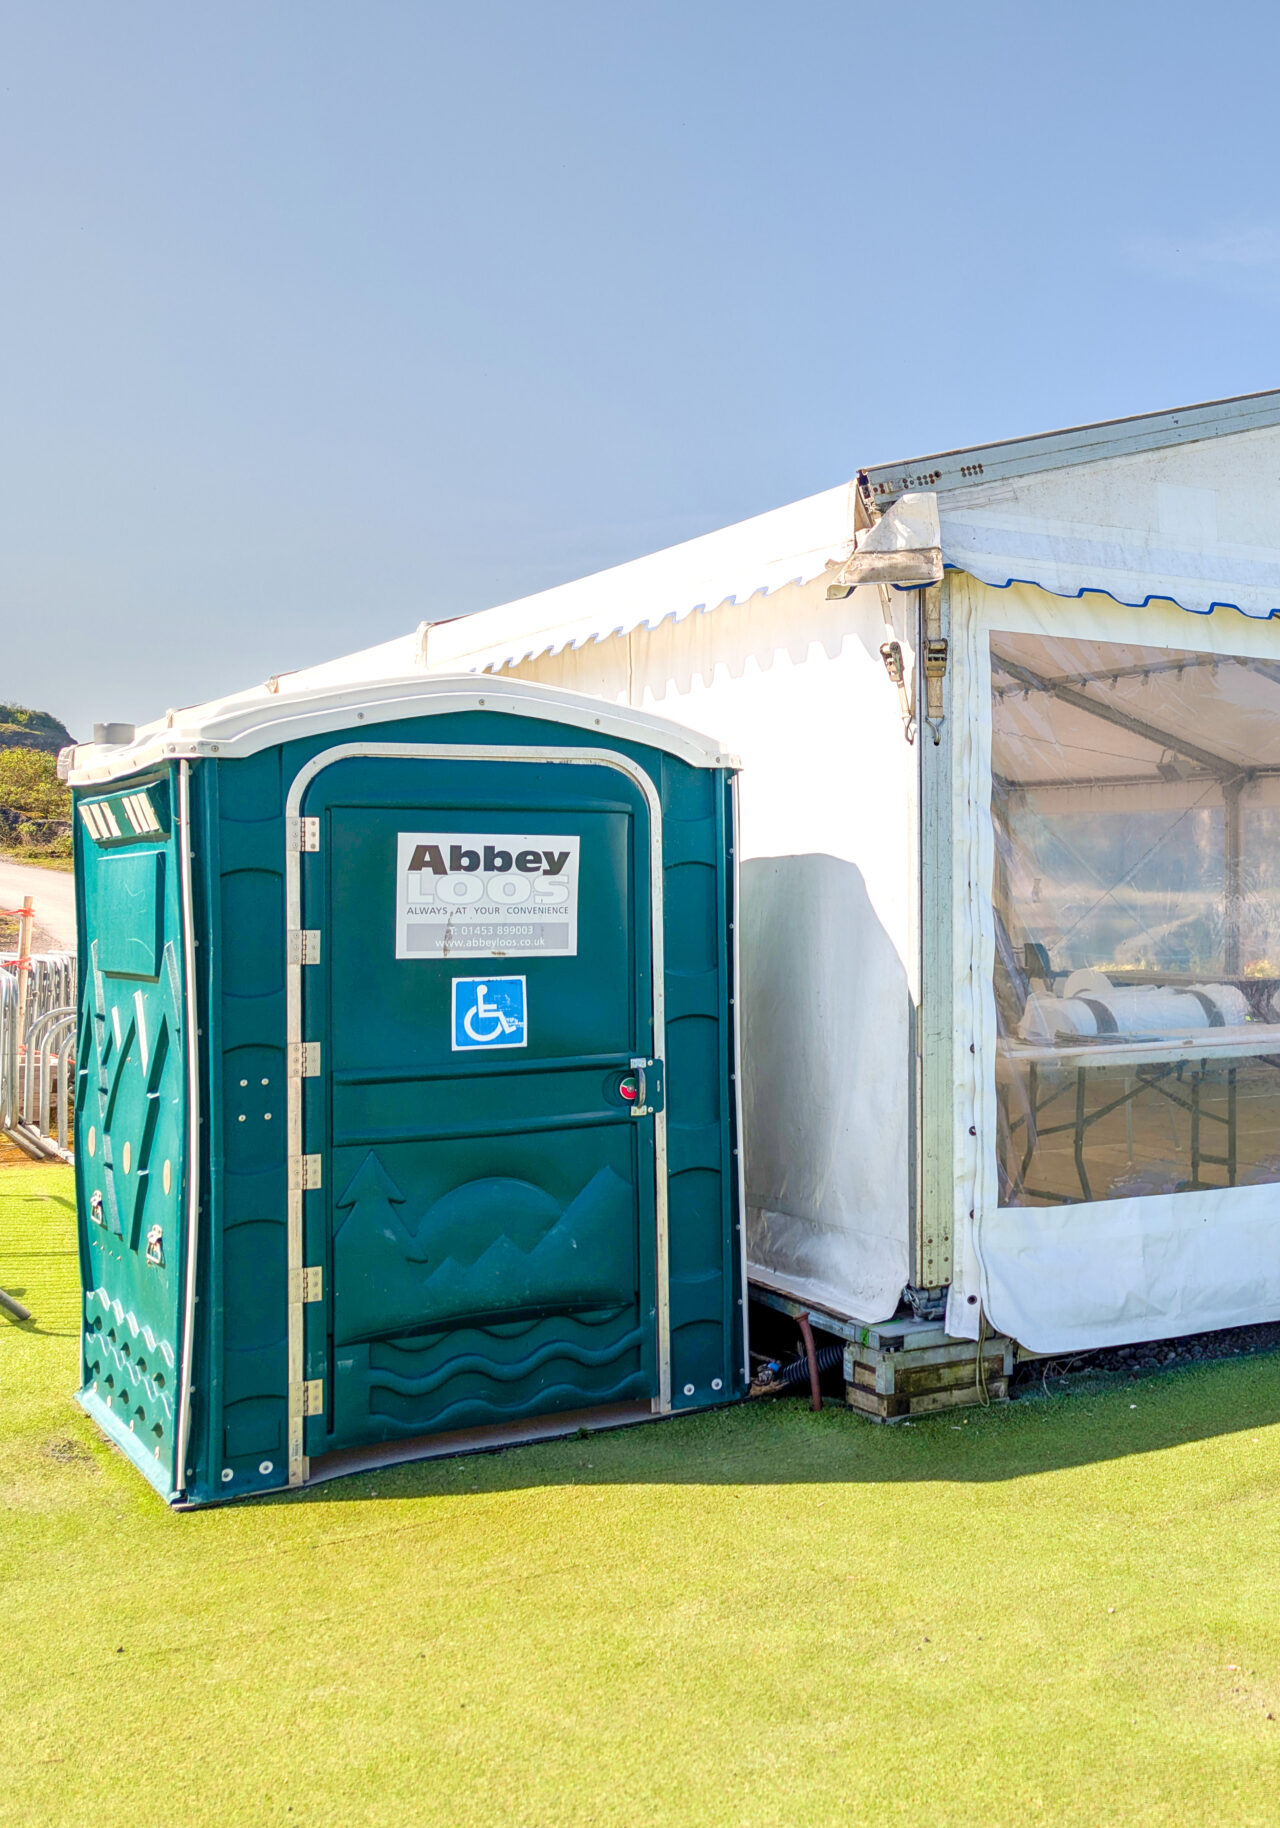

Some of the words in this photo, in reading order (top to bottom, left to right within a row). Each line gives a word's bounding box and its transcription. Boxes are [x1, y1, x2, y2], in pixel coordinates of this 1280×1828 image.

[407, 844, 570, 876] Abbey
[406, 872, 570, 905] LOOS
[406, 906, 448, 915] ALWAYS
[455, 906, 467, 915] AT
[473, 906, 500, 915] YOUR
[506, 906, 569, 915] CONVENIENCE
[449, 926, 458, 936] T:
[461, 926, 493, 936] 01453
[496, 925, 534, 935] 899003
[435, 937, 545, 948] www.abbeyloos.co.uk
